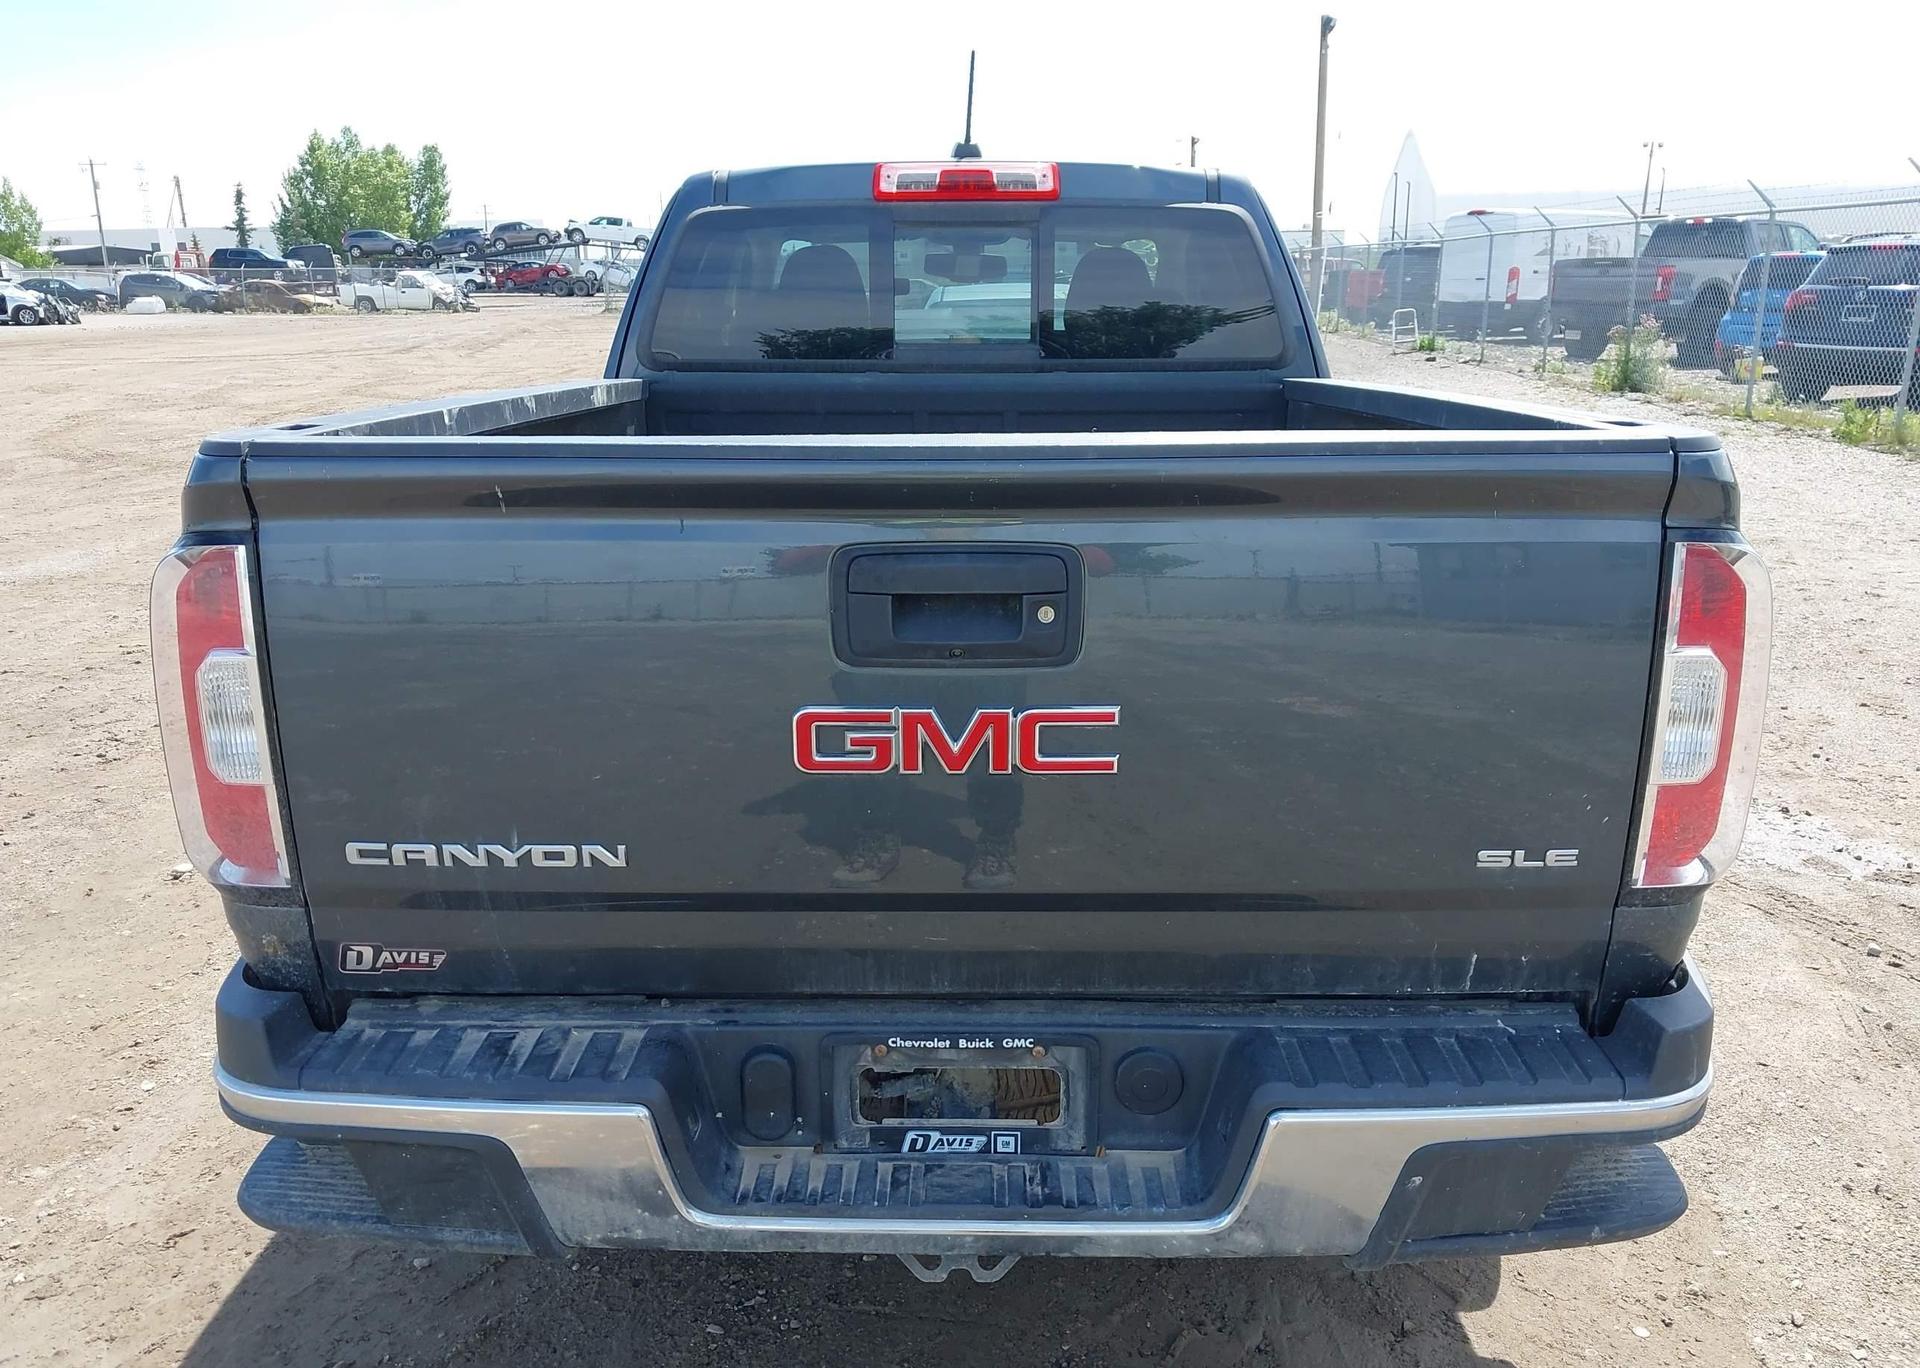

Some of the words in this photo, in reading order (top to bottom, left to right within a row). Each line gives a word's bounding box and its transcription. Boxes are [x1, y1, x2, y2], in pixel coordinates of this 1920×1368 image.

[793, 705, 1121, 774] GMC
[345, 841, 629, 868] CANYON
[1476, 849, 1580, 867] SLE
[346, 945, 430, 970] DAVIS
[888, 1037, 950, 1048] Chevrolet
[958, 1038, 994, 1048] Buick
[1002, 1038, 1034, 1048] GMC
[908, 1133, 974, 1152] DAVIS
